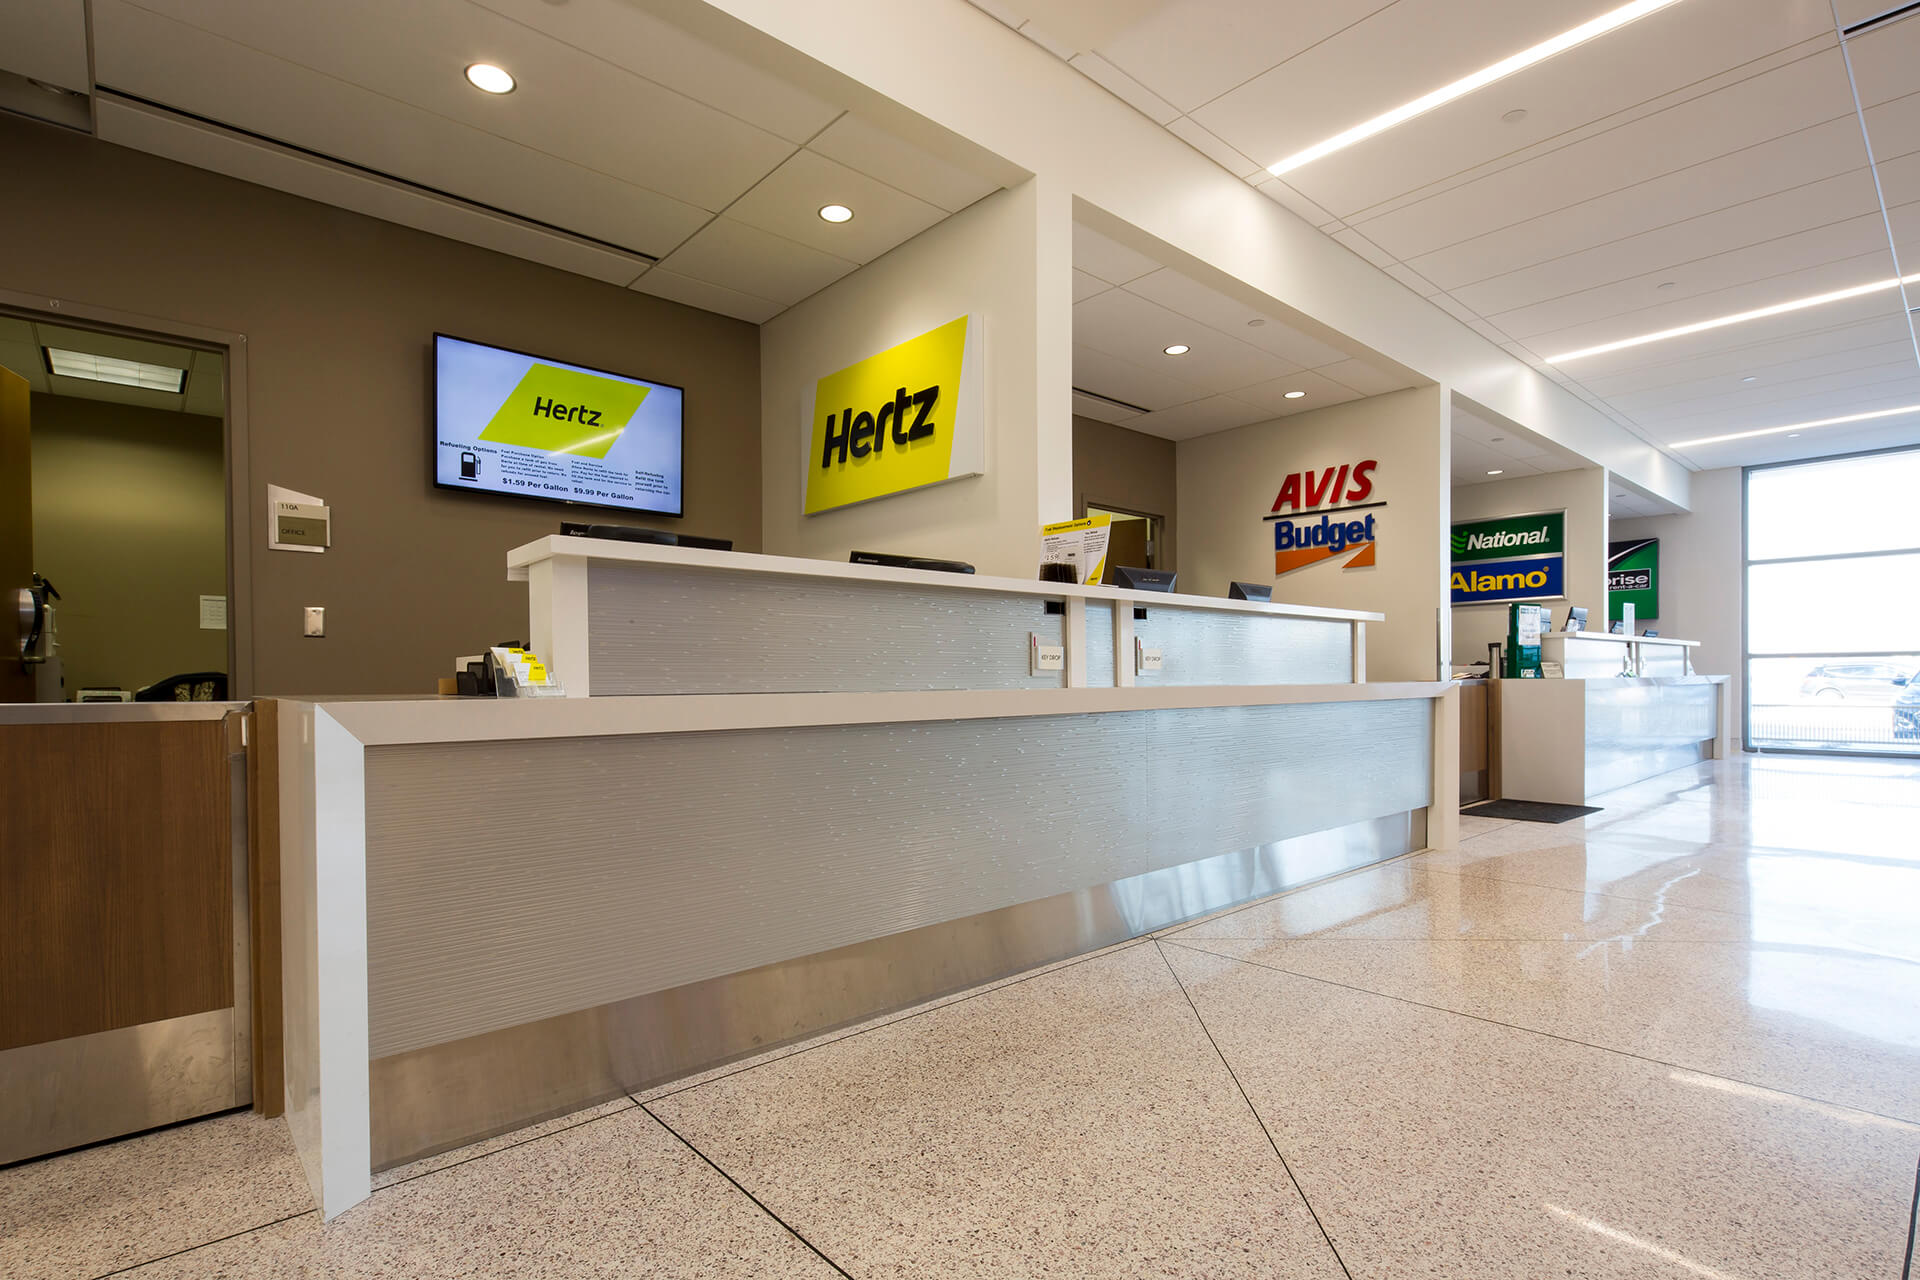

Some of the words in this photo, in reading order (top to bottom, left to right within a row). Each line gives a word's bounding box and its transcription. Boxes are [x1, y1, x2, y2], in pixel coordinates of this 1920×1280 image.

[533, 396, 602, 427] Hertz
[822, 385, 939, 468] Hertz
[440, 441, 471, 450] Refueling
[473, 446, 498, 454] Options
[502, 478, 525, 486] $1.59
[544, 483, 568, 492] Gallon
[574, 488, 594, 496] $9.99
[611, 492, 634, 500] Gallon
[1271, 460, 1377, 512] AVIS
[281, 528, 305, 536] OFFICE
[1275, 513, 1375, 552] Budget
[1467, 526, 1548, 550] National
[1451, 570, 1547, 592] Alamo
